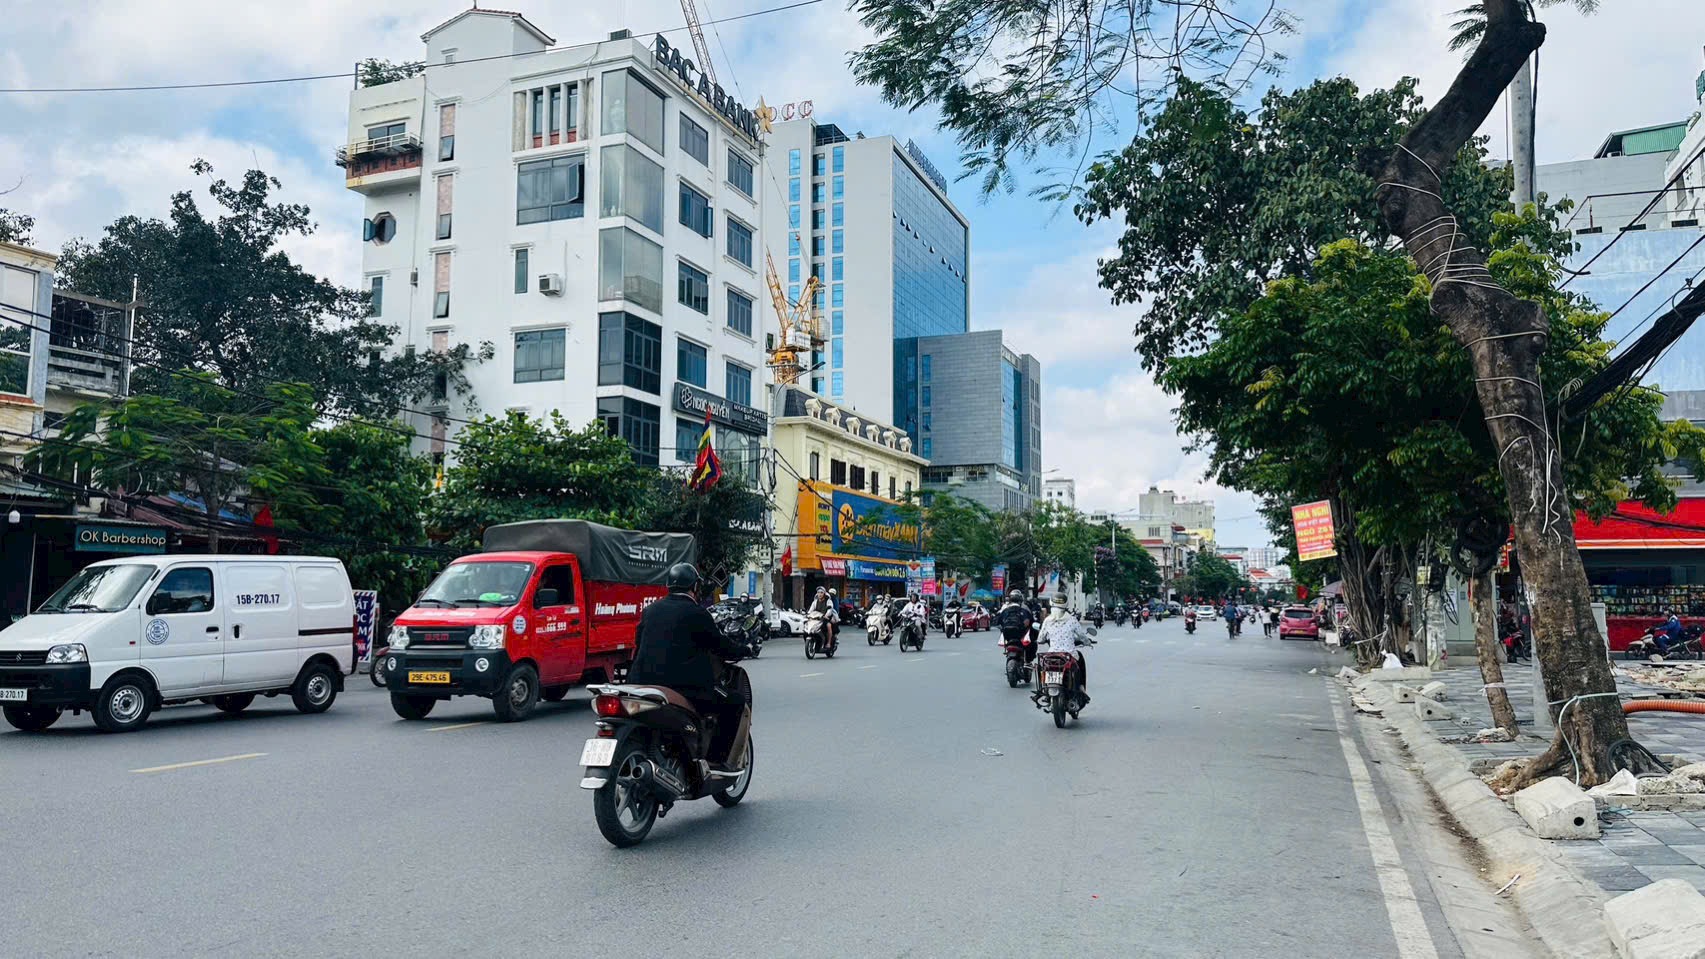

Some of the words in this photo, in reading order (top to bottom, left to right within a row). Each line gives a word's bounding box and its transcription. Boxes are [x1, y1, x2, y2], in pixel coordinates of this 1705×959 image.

[656, 33, 695, 87] BAC
[697, 72, 712, 103] A
[713, 83, 762, 142] BANK
[81, 530, 99, 542] OK
[102, 531, 166, 547] Barbershop
[628, 545, 668, 563] SRM
[236, 594, 280, 605] 15B-270.17
